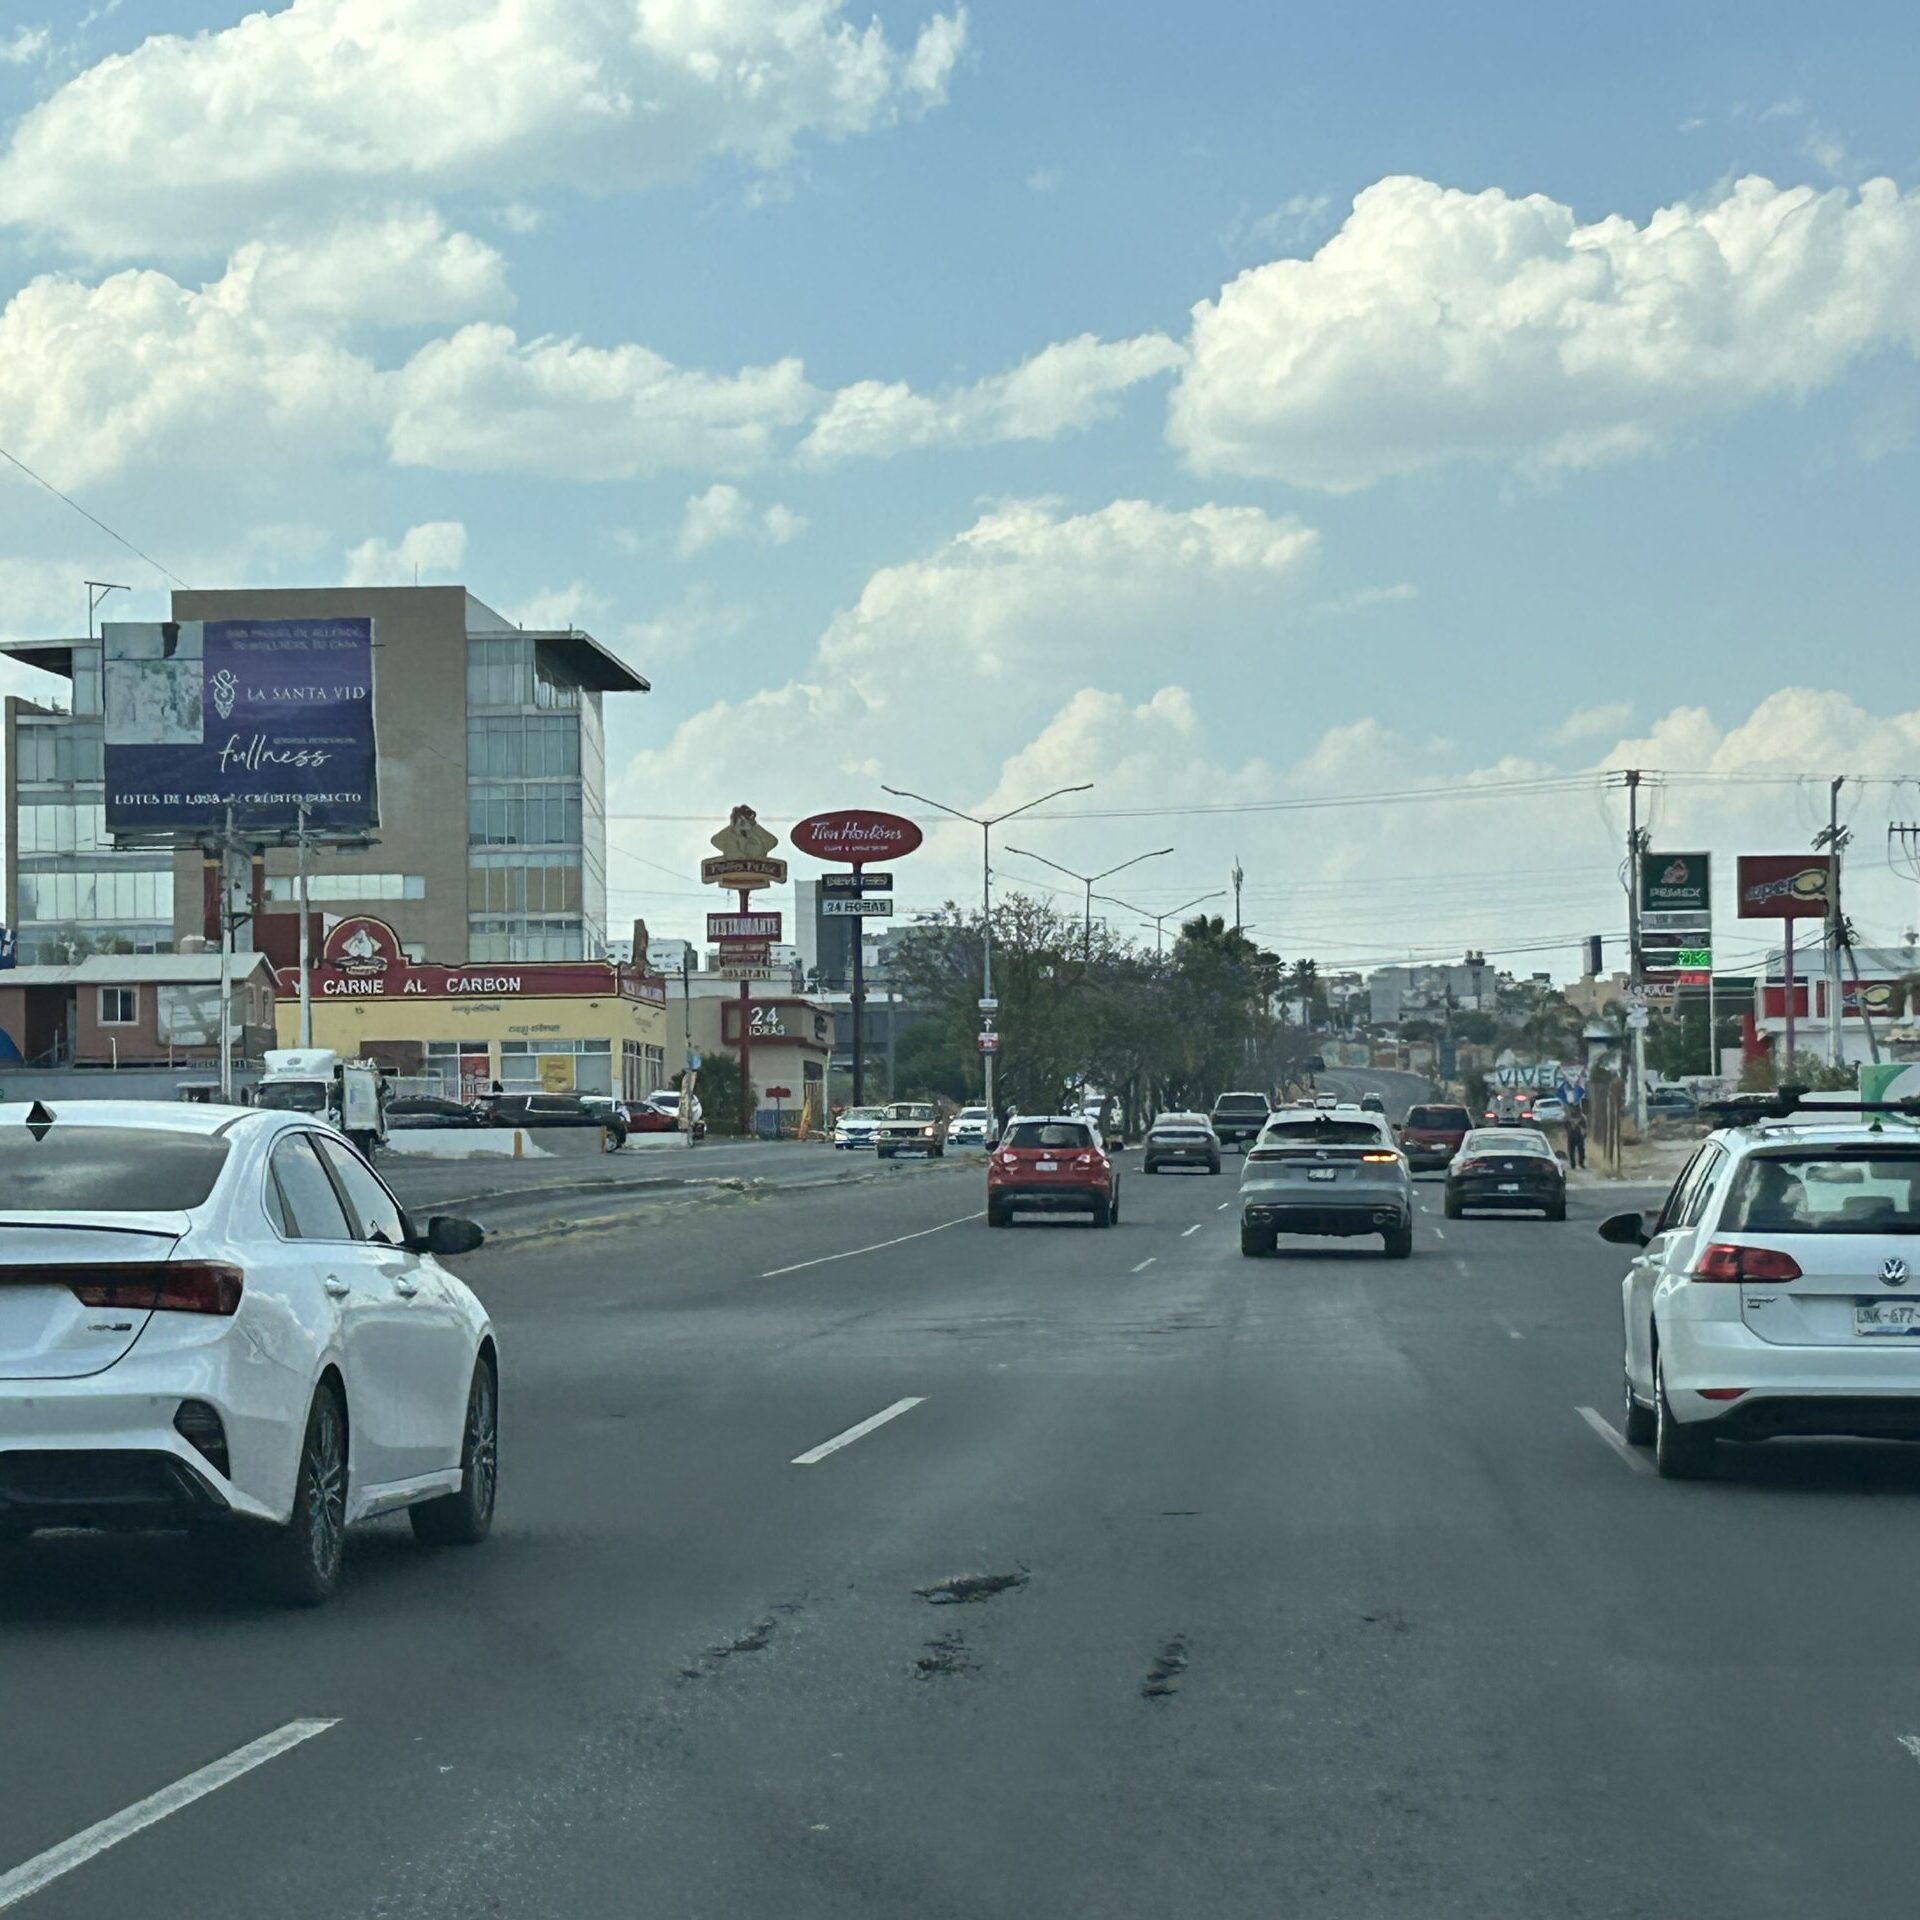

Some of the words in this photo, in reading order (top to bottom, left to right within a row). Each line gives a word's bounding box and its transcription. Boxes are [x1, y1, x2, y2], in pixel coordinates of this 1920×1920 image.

[247, 687, 266, 700] LA
[273, 686, 326, 700] SANTA
[334, 685, 366, 700] VID
[218, 734, 332, 773] fullness
[811, 822, 839, 839] Tim
[323, 979, 385, 994] CARNE
[403, 980, 427, 993] AL
[446, 977, 520, 992] CARBON
[750, 1007, 779, 1025] 24
